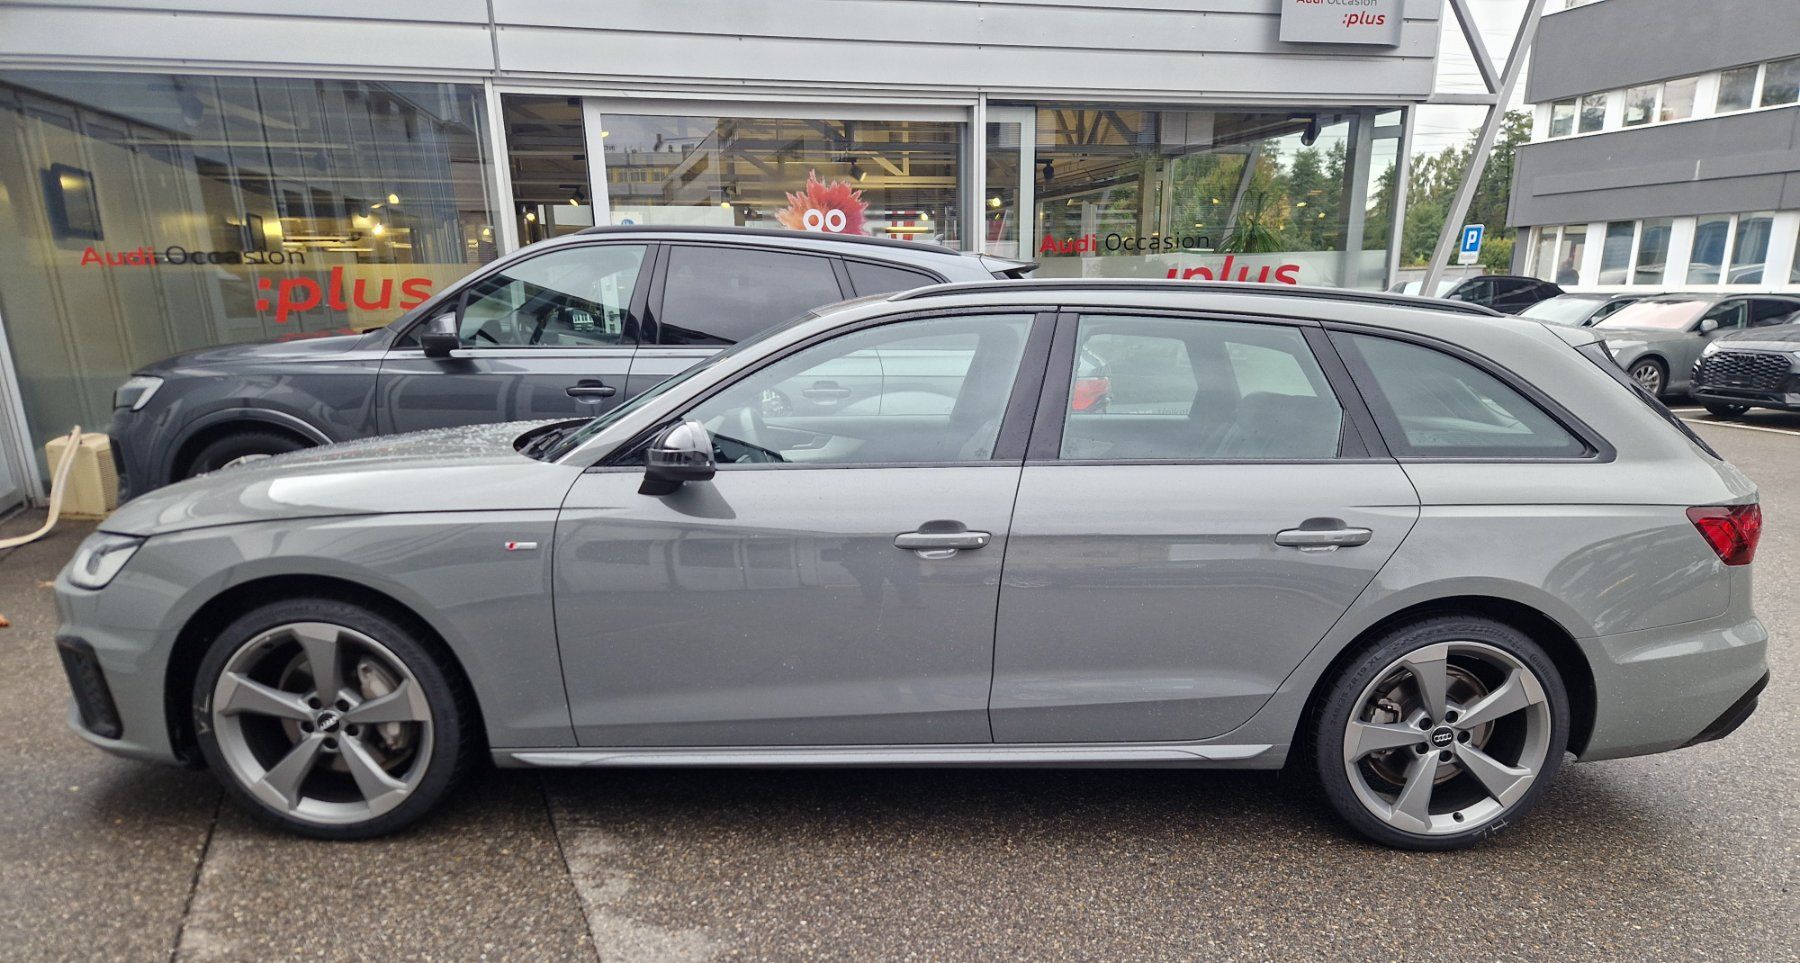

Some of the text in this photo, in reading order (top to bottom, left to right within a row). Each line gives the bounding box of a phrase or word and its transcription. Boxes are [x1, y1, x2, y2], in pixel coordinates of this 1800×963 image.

[1342, 11, 1386, 28] :plus
[1039, 231, 1210, 254] Audi Occasion
[1465, 230, 1478, 250] P
[80, 245, 306, 267] Audi Occasion
[256, 266, 433, 323] :plus
